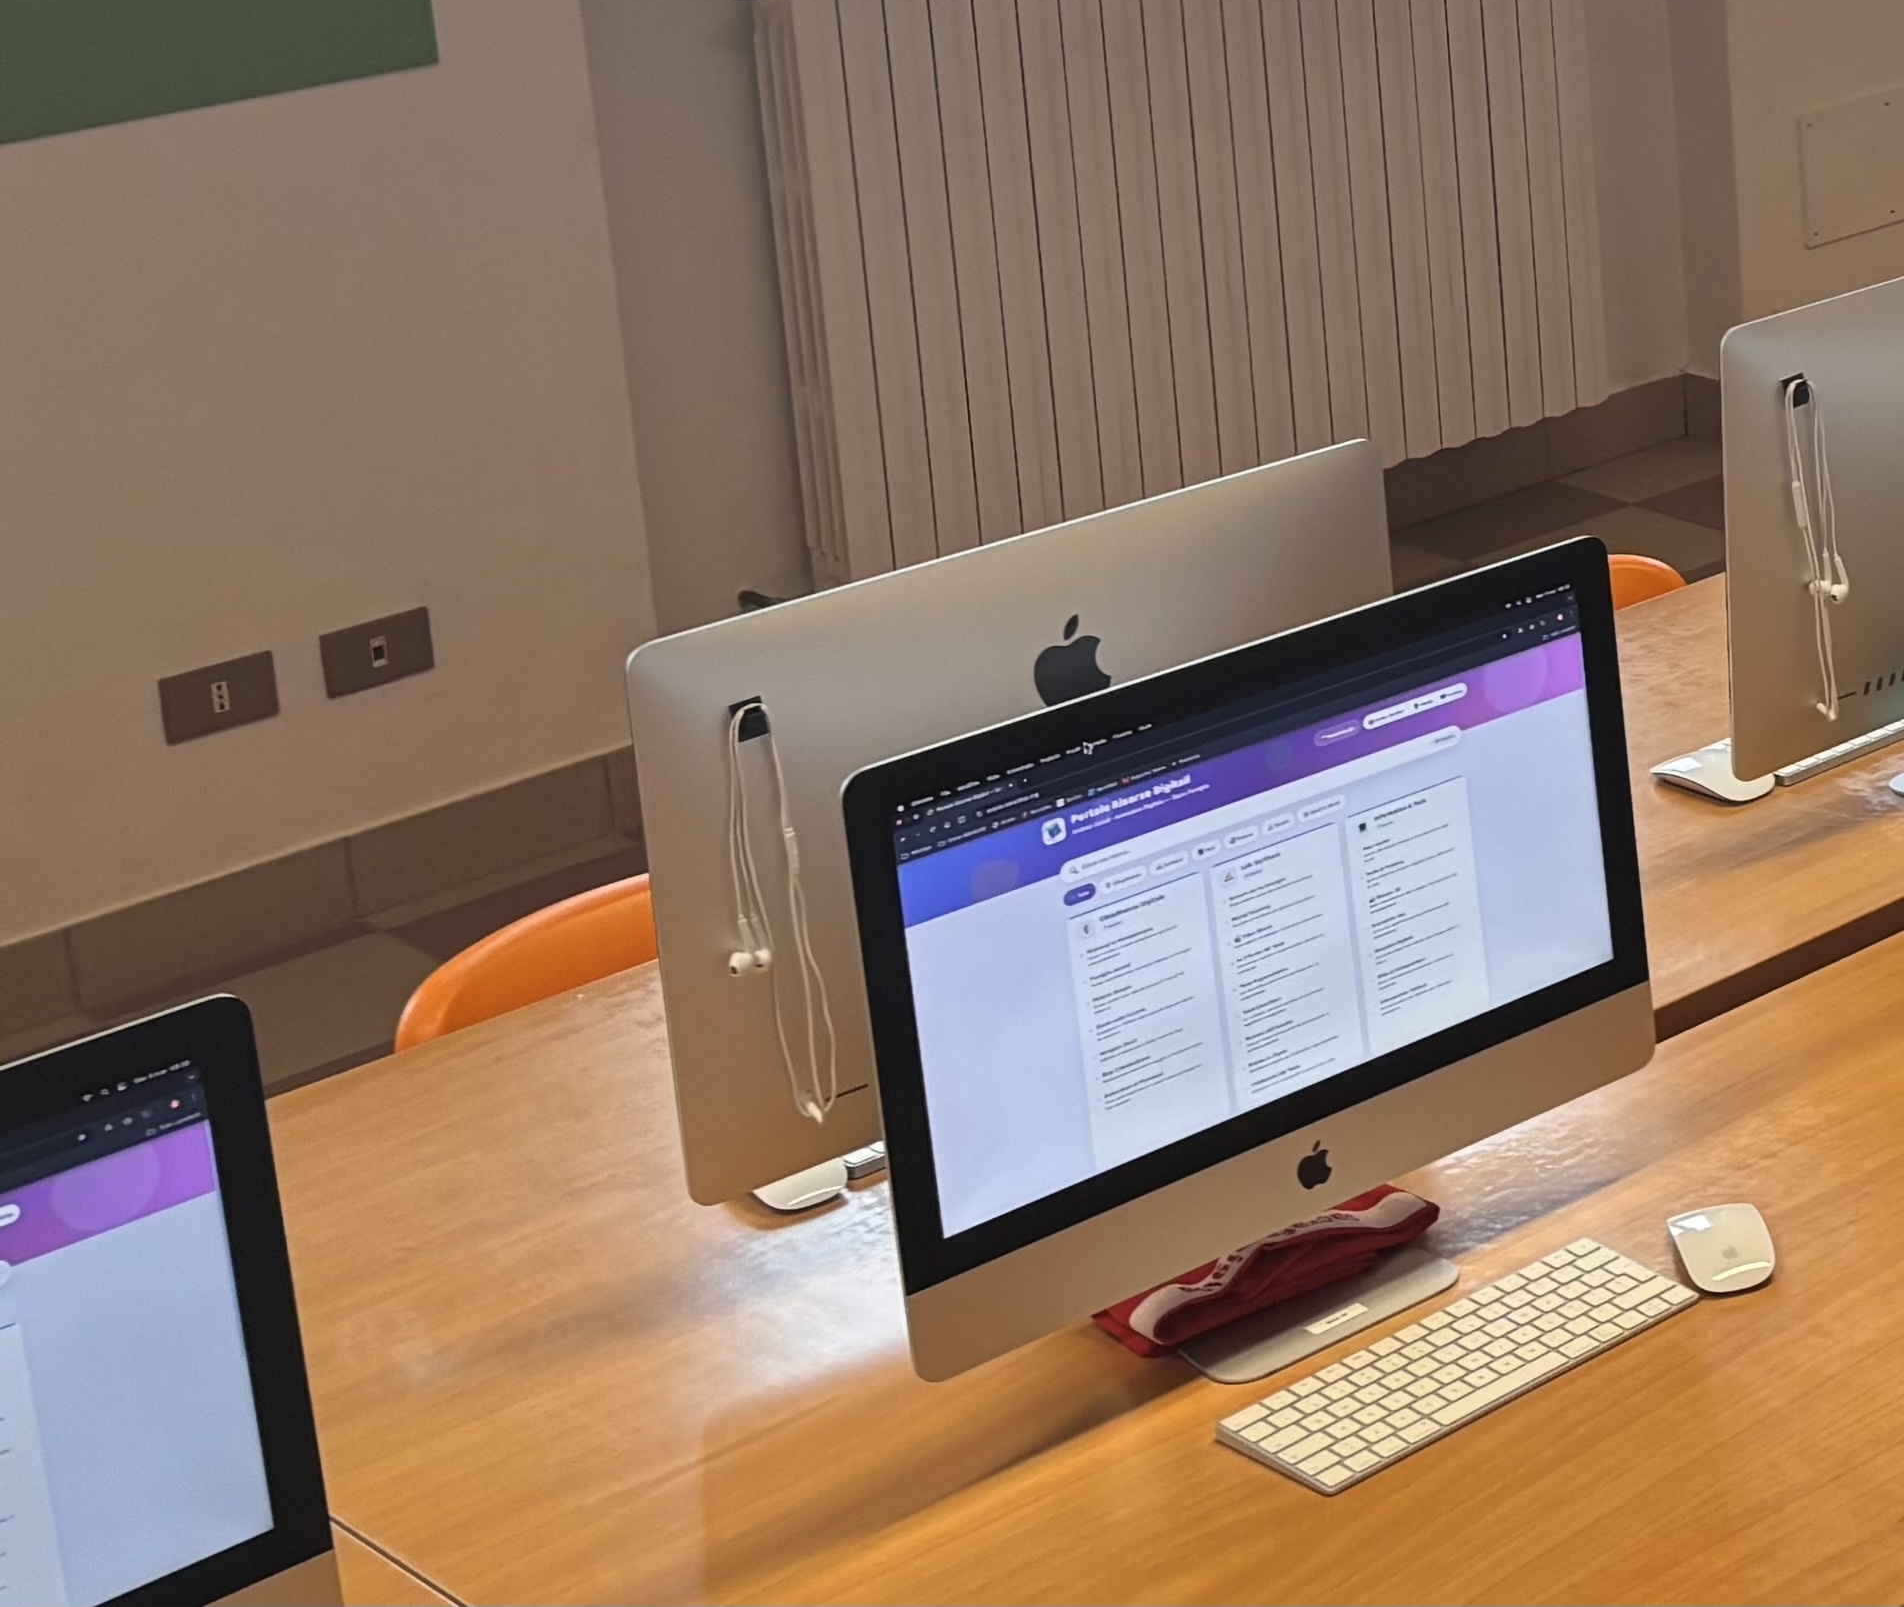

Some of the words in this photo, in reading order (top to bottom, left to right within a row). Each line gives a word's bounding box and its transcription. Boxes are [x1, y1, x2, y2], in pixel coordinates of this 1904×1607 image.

[1070, 801, 1110, 824] Portale
[1111, 789, 1152, 810] Risorse
[1152, 774, 1192, 797] Digitali
